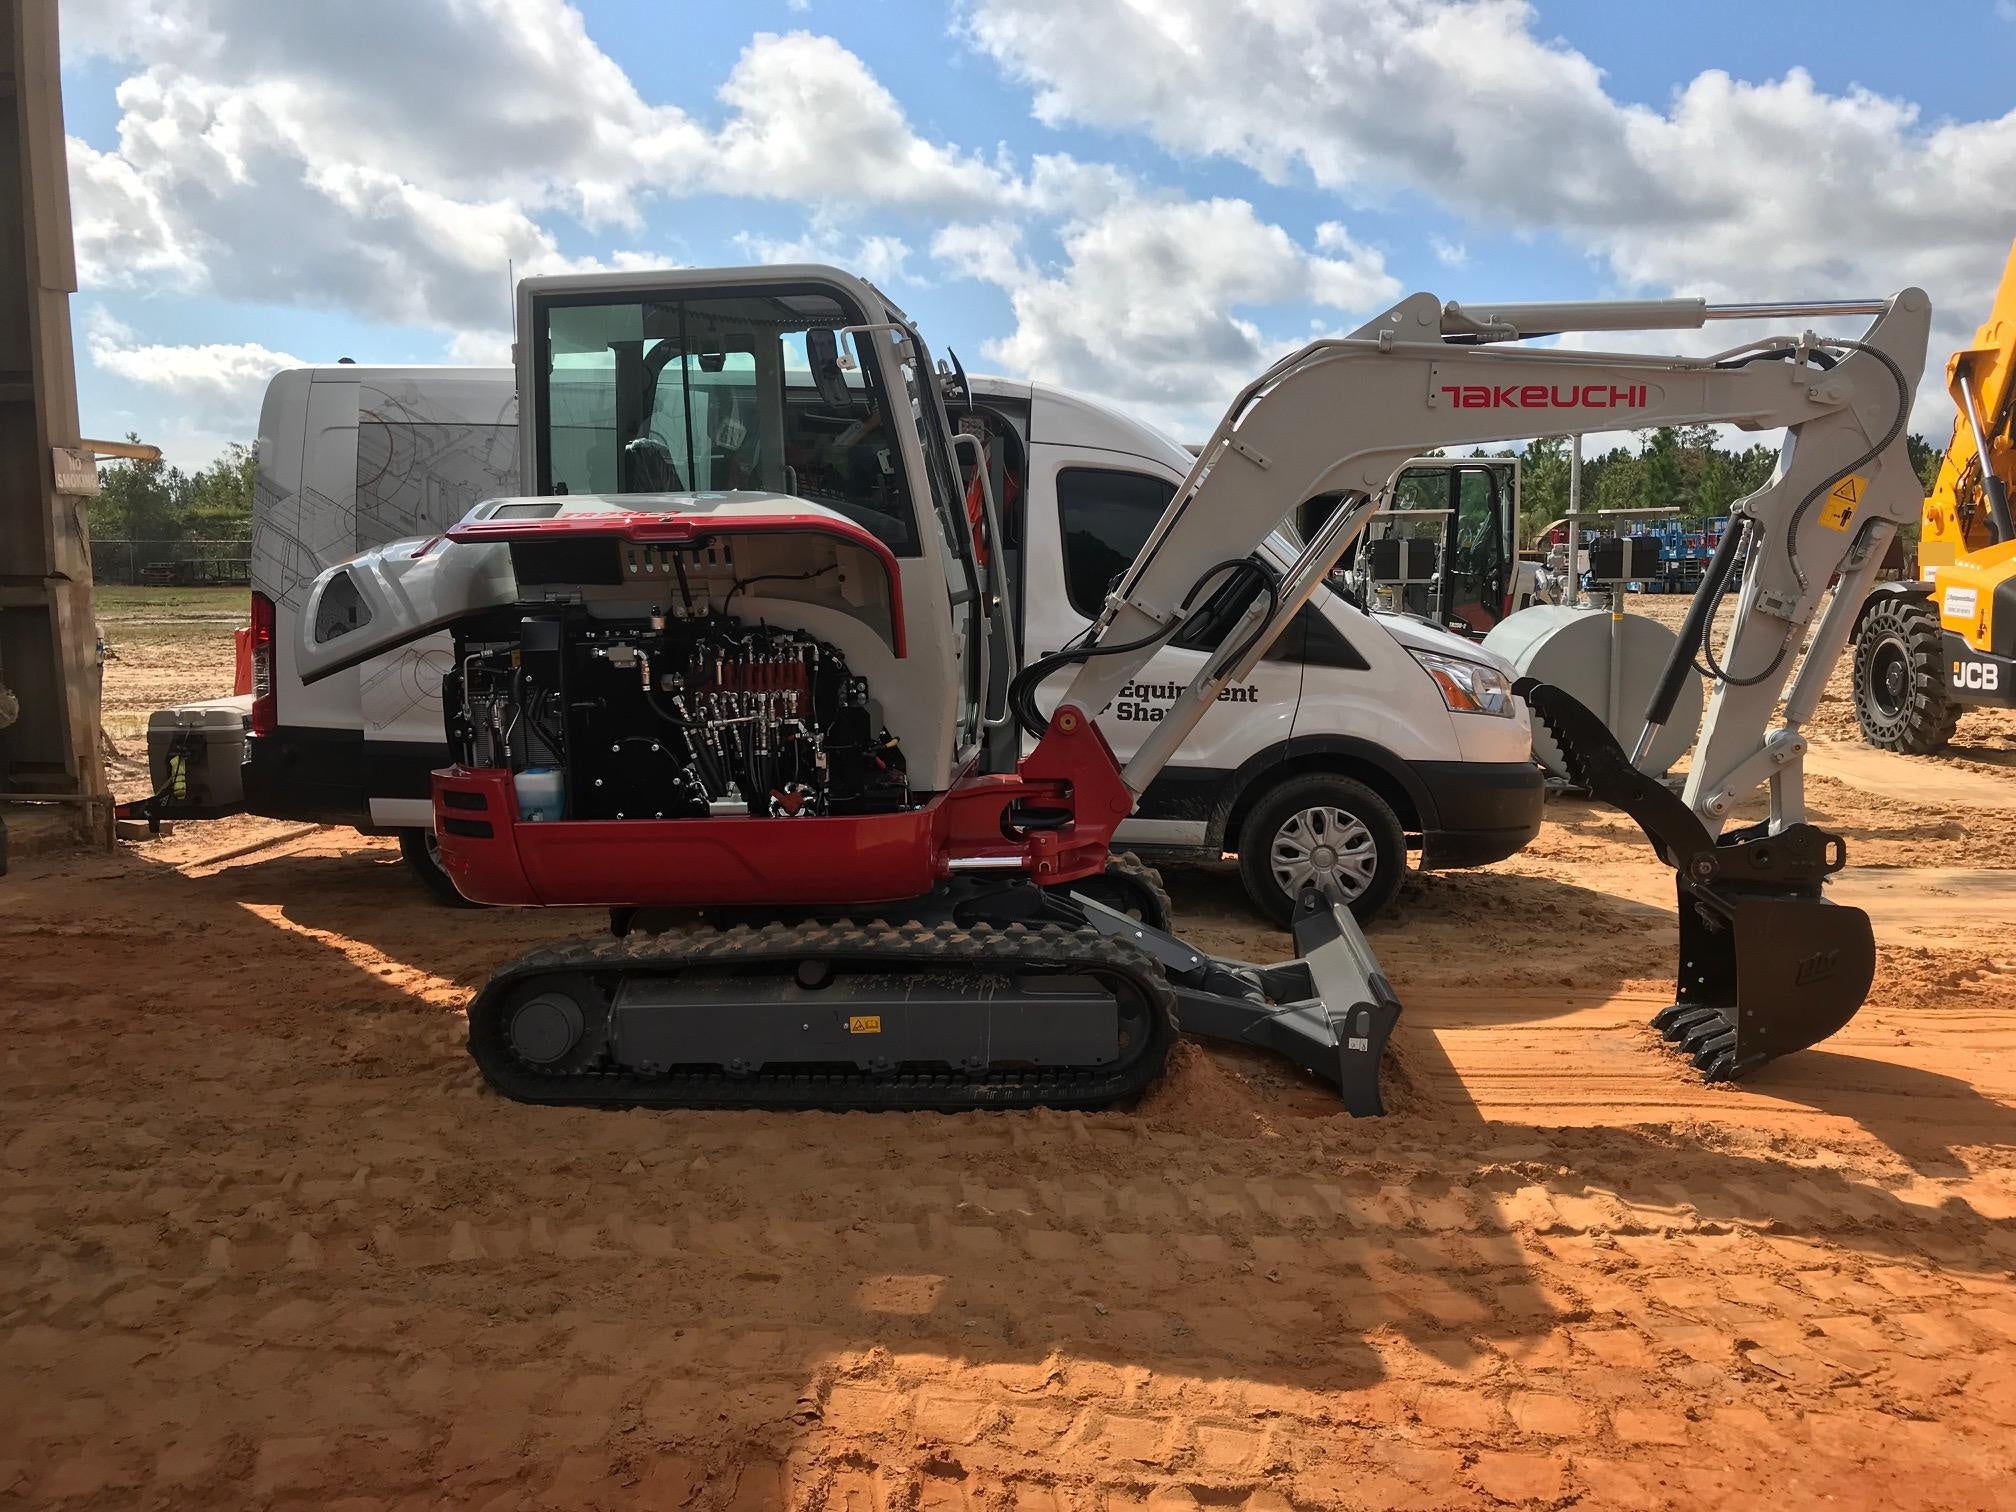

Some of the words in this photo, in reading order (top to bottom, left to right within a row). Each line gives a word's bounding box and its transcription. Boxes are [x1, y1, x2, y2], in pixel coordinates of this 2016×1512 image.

[69, 457, 82, 471] NO
[57, 473, 97, 489] SMOKING
[1953, 661, 1999, 690] JCB
[1118, 680, 1259, 703] Equient
[1116, 702, 1173, 722] Sha
